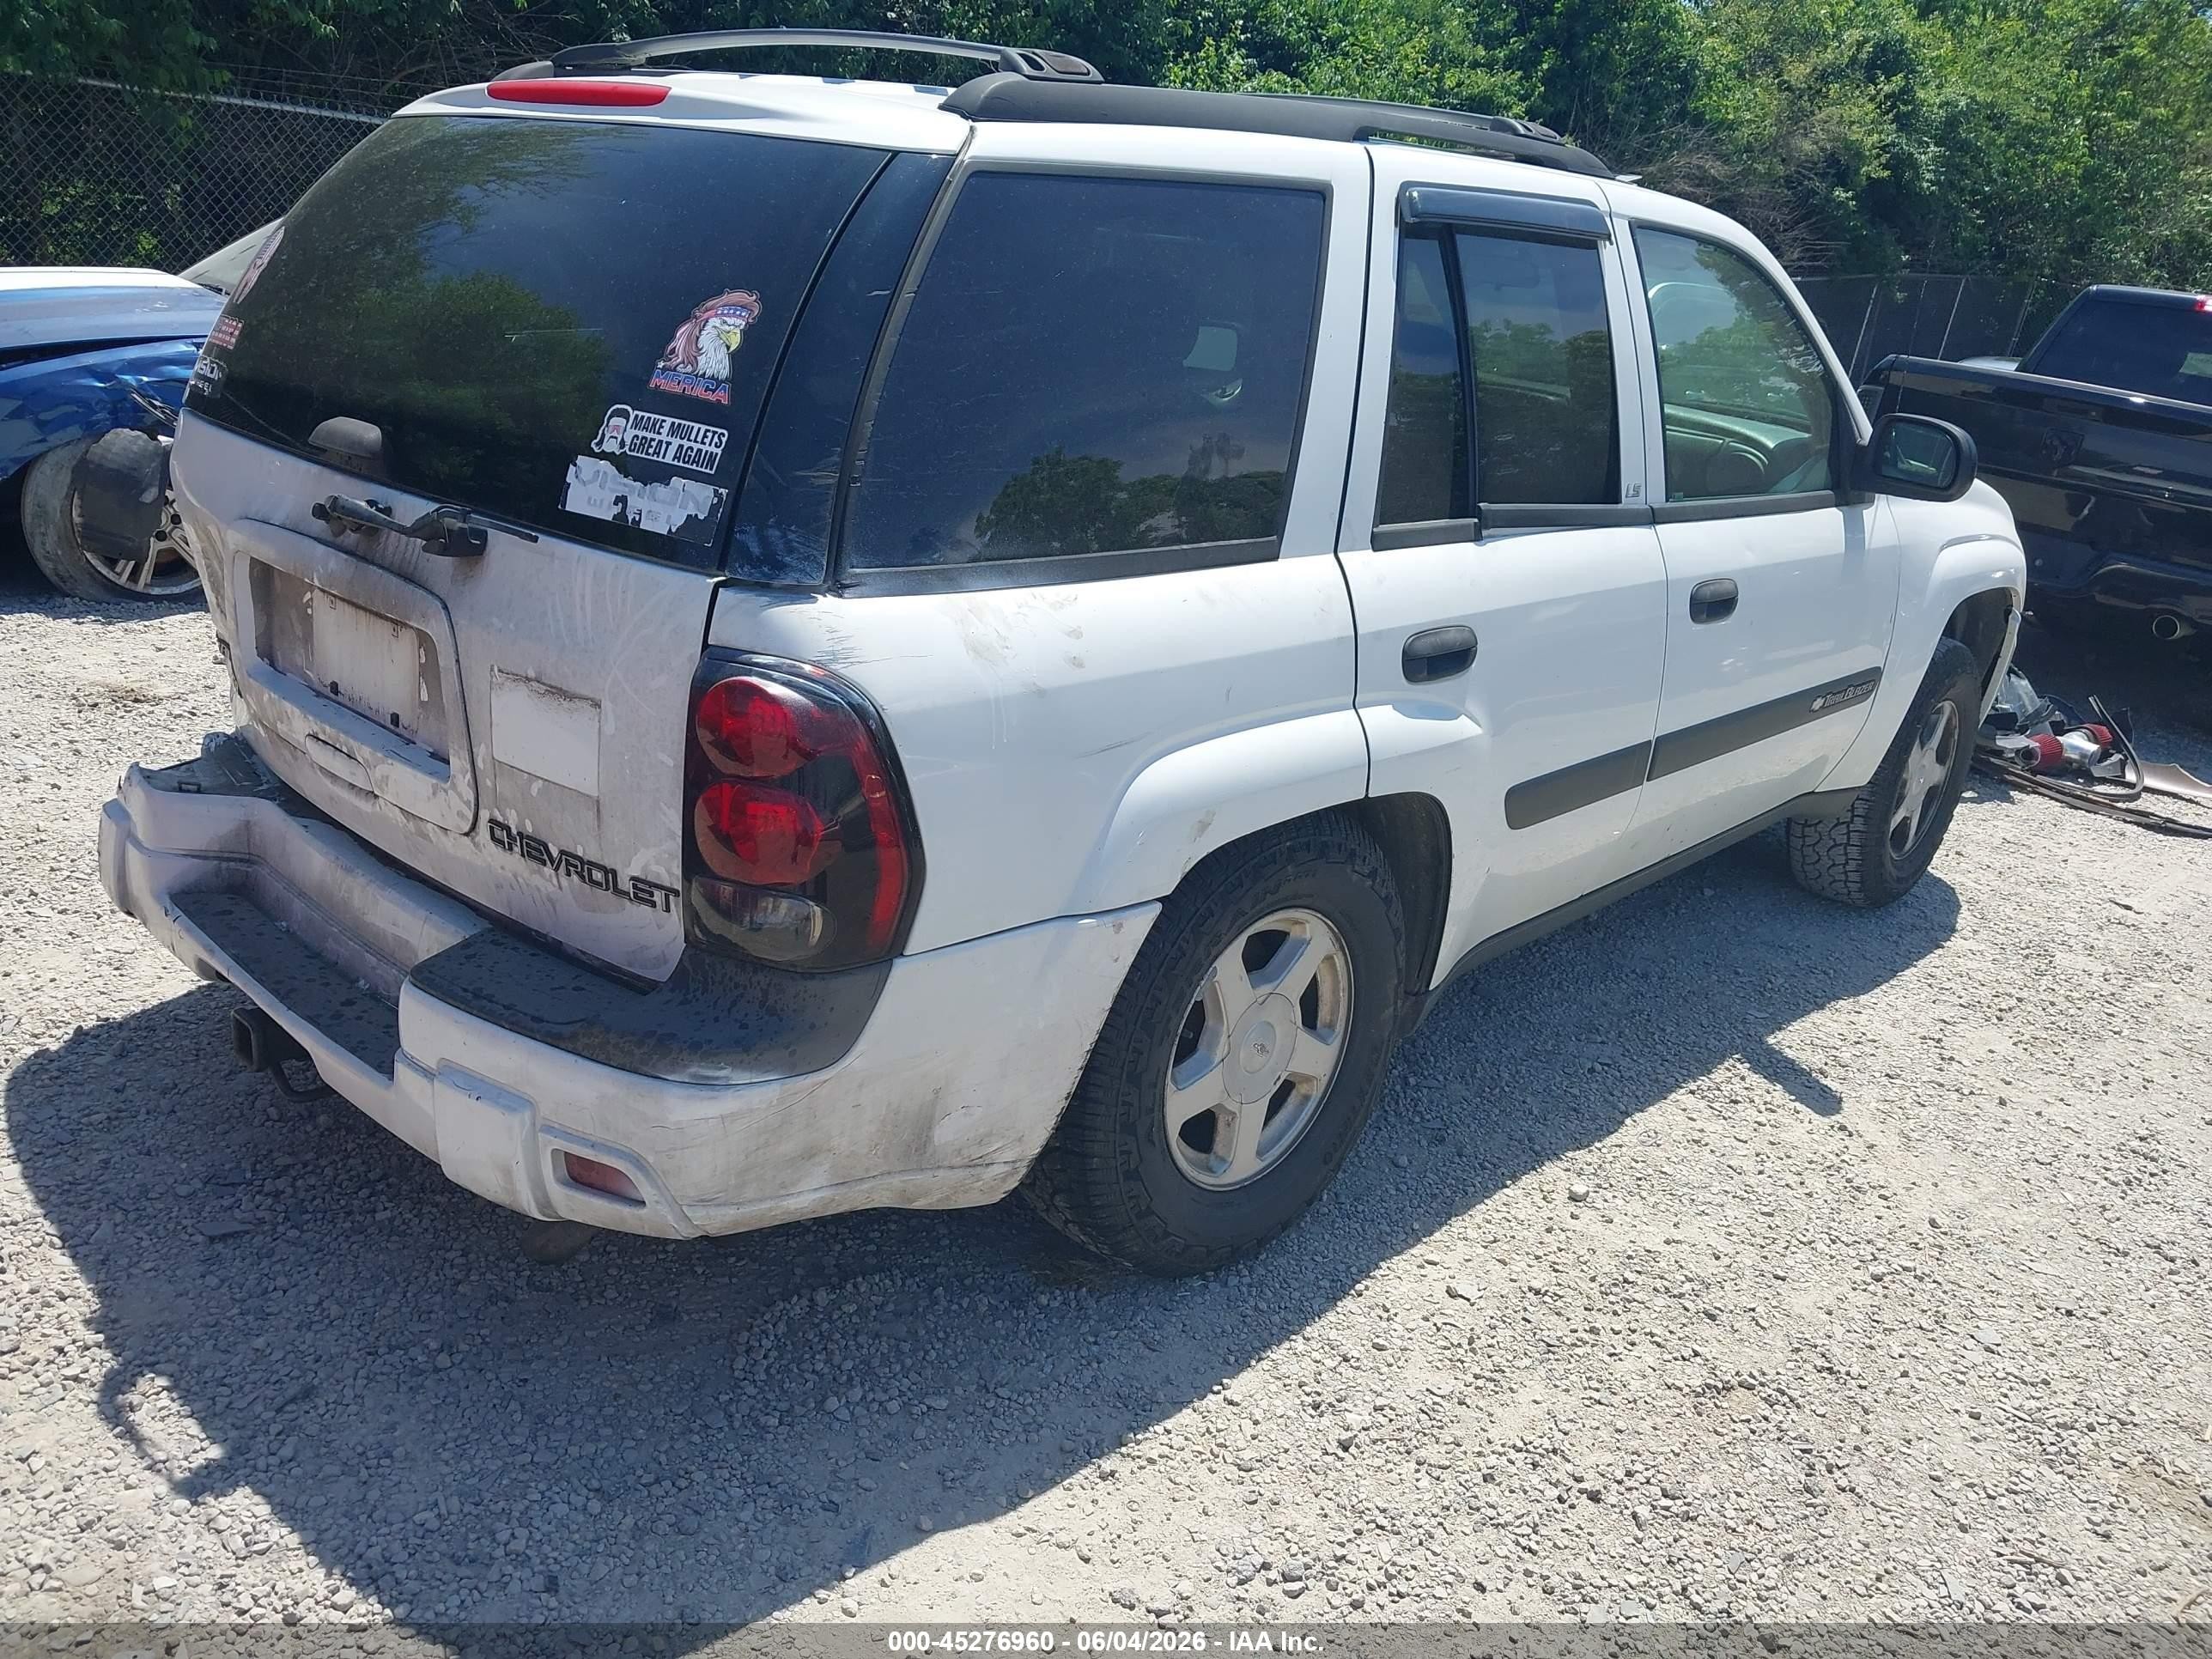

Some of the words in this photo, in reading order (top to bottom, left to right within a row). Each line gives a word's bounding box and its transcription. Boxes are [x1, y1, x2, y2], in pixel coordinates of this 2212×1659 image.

[649, 368, 730, 404] MERICA
[630, 412, 668, 438] MAKE
[667, 420, 726, 449] MULLETS
[629, 435, 671, 461] GREAT
[672, 446, 720, 471] AGAIN
[1626, 483, 1642, 498] LS
[488, 818, 680, 913] CHEVROLET
